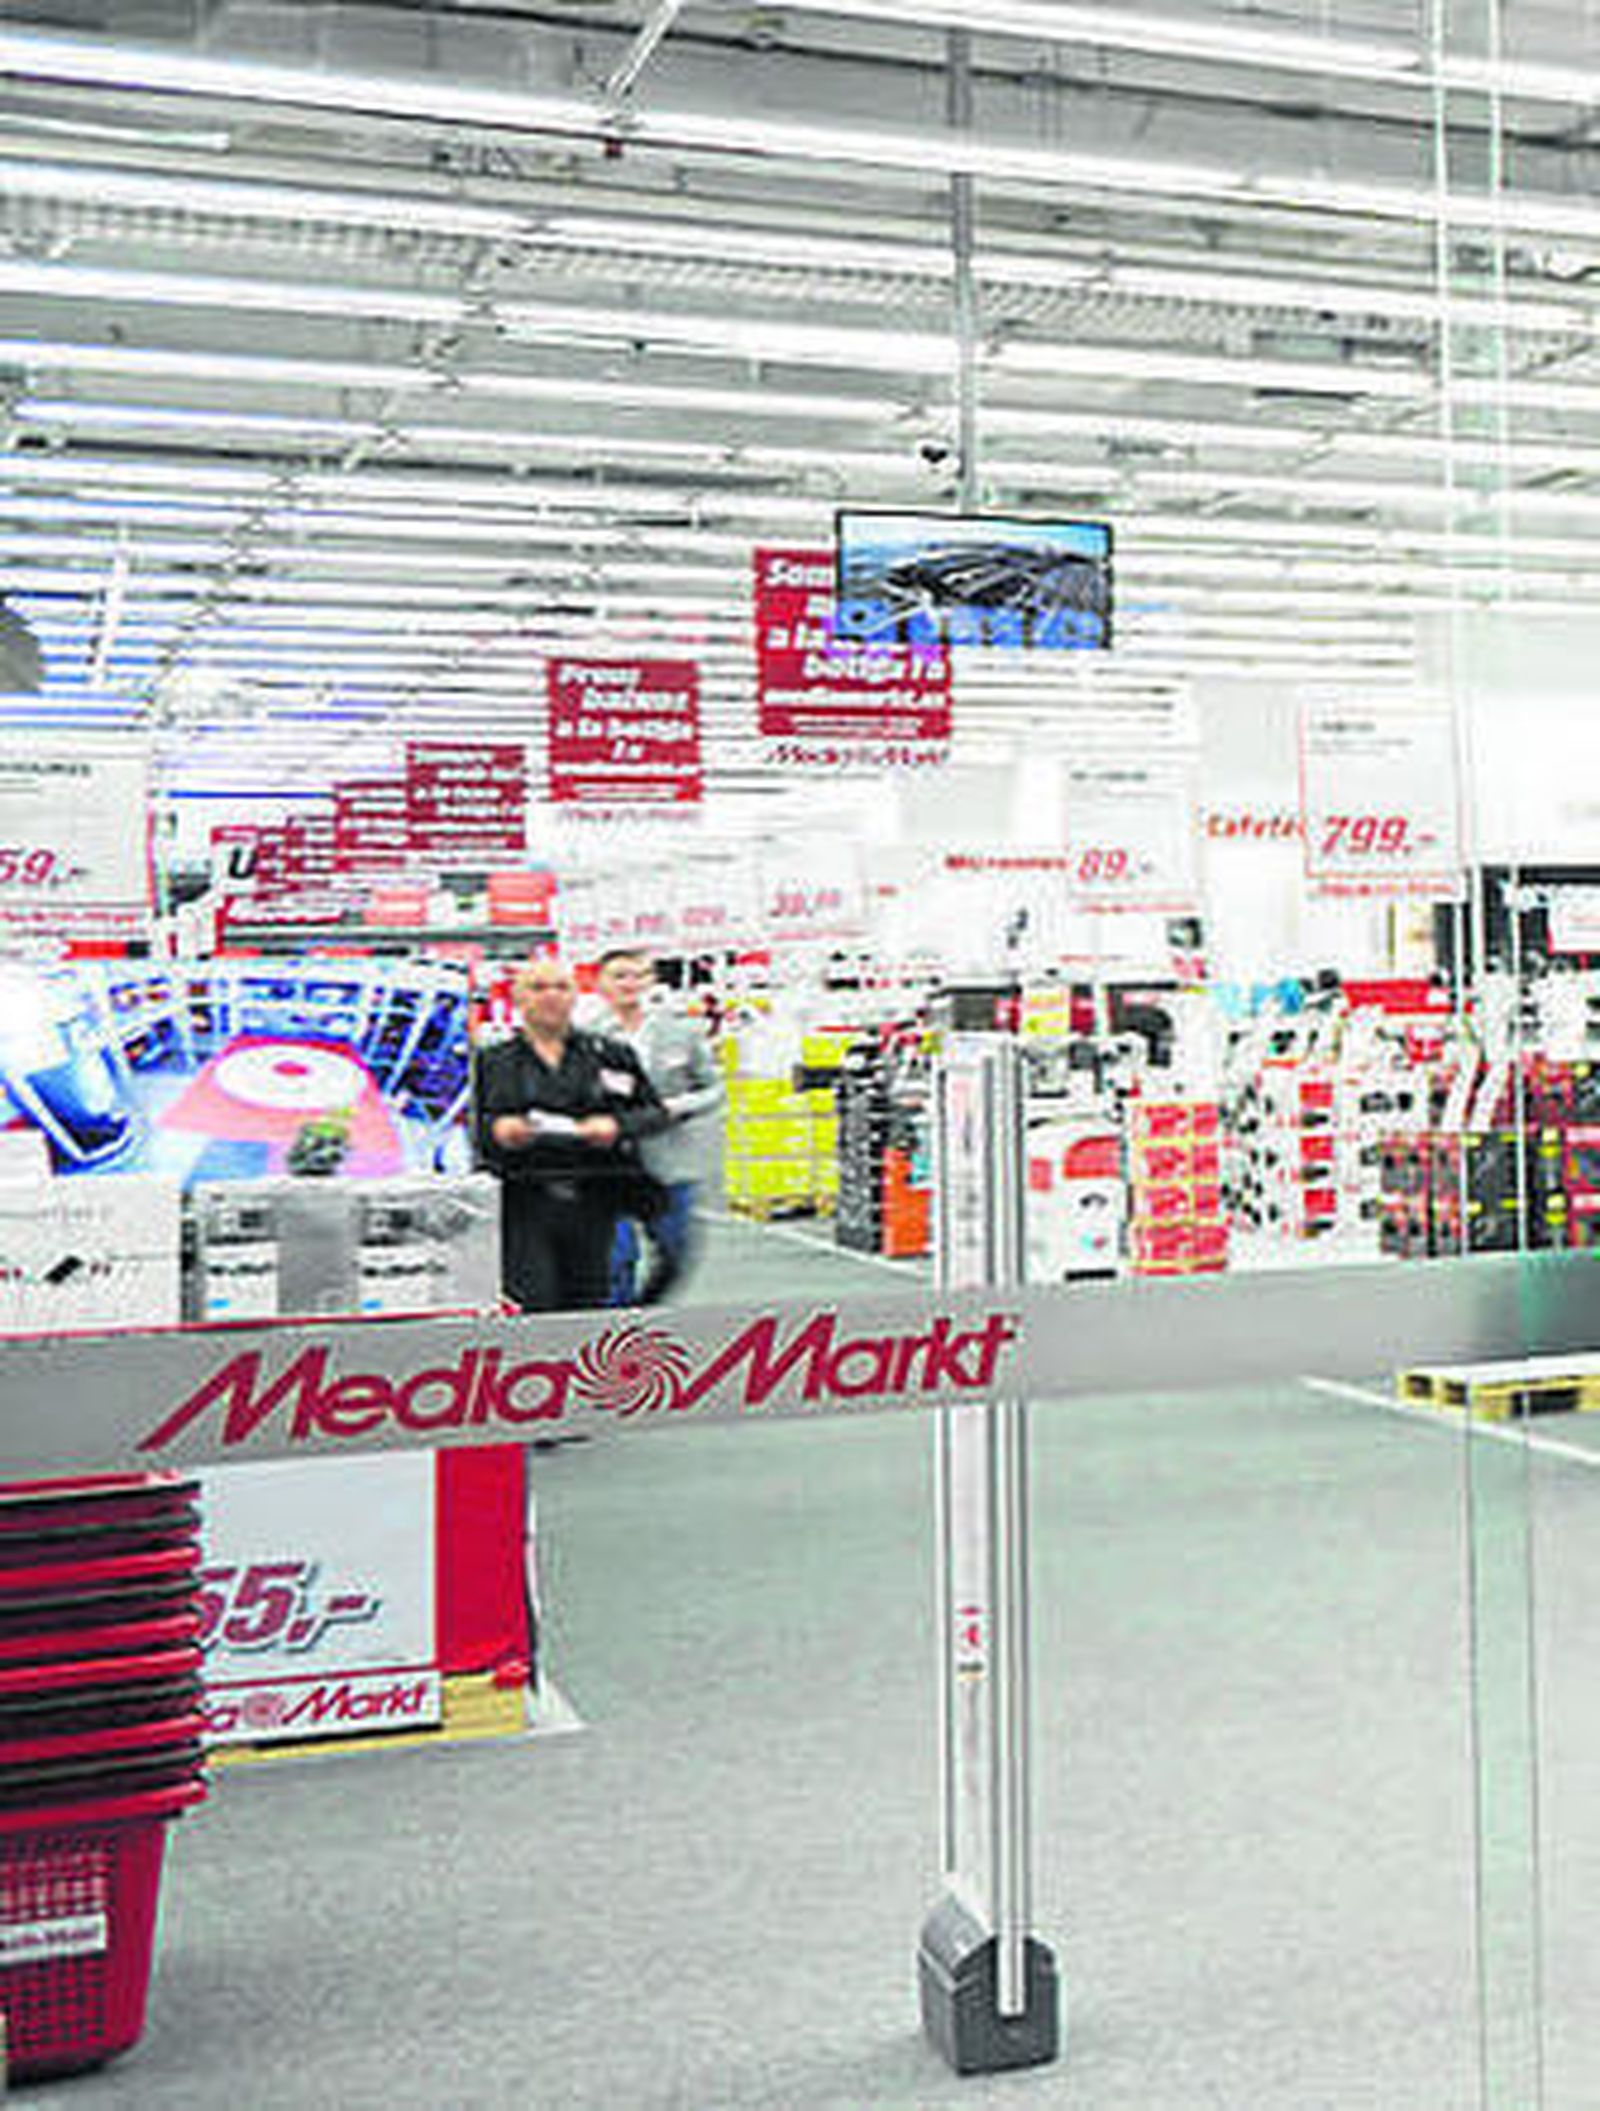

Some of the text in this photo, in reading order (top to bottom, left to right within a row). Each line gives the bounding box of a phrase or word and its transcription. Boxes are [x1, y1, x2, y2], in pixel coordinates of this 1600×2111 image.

[138, 1310, 1022, 1454] Media Markt
[282, 1682, 428, 1726] Markt
